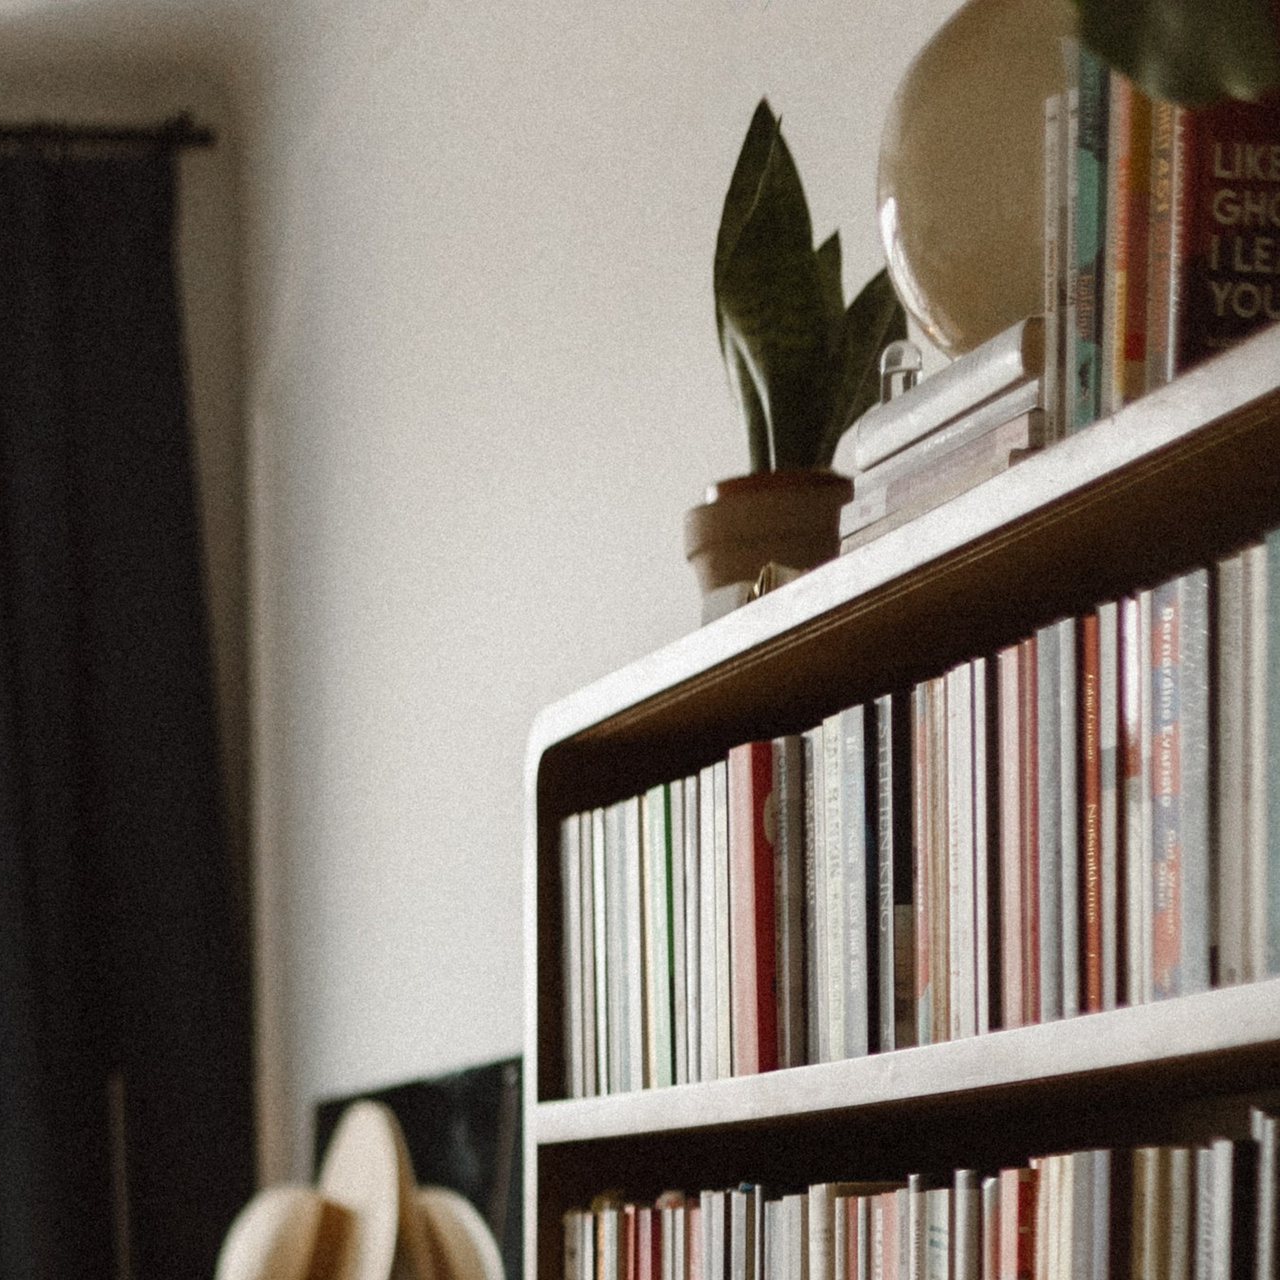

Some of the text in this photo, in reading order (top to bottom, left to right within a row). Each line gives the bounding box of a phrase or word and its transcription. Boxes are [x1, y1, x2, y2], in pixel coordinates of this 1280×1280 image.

[1209, 234, 1219, 272] I
[1162, 606, 1175, 808] Bernardine Evaristo
[879, 721, 891, 933] STEPHEN KING
